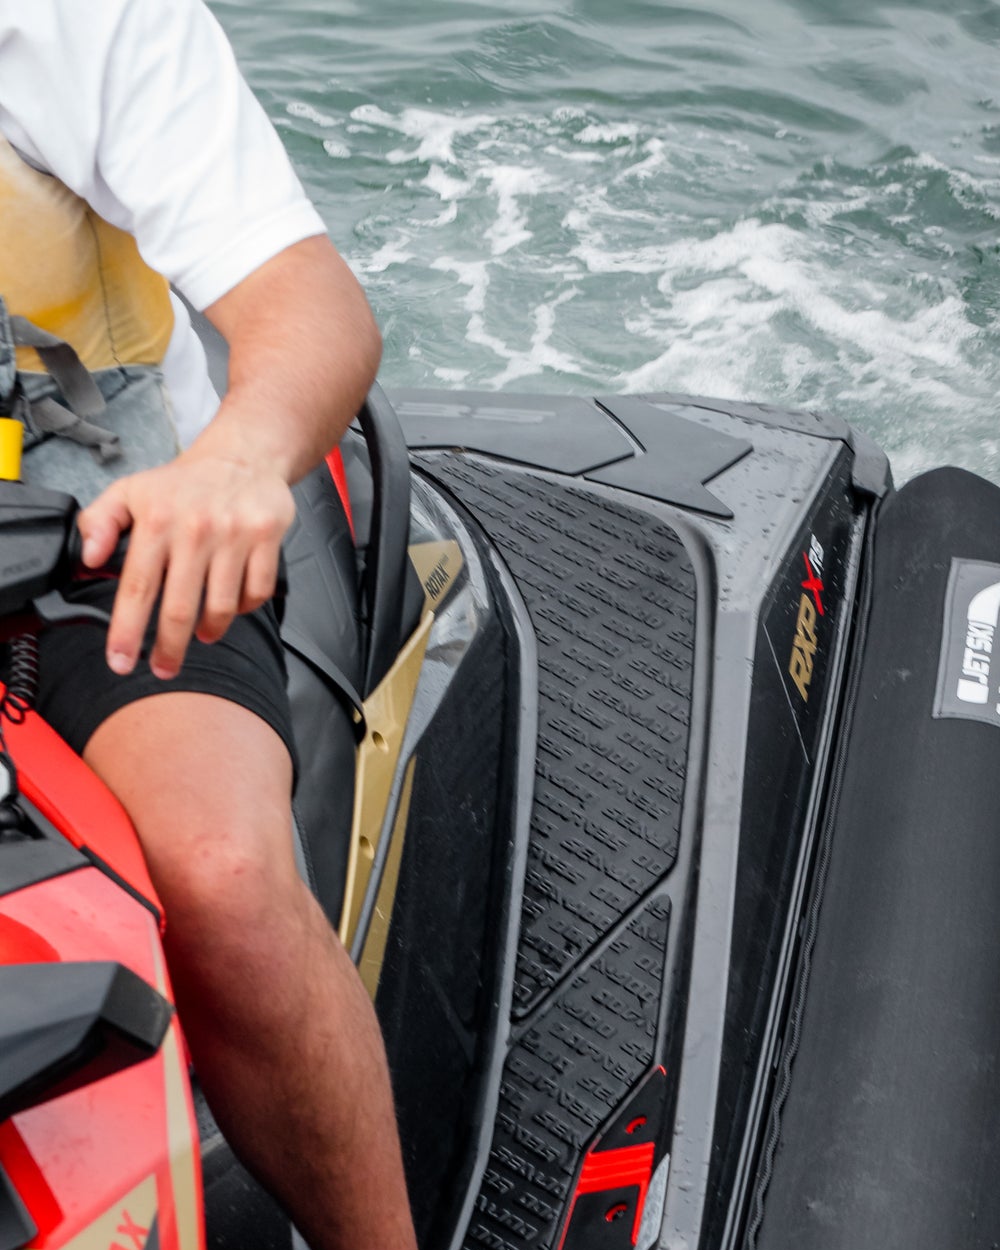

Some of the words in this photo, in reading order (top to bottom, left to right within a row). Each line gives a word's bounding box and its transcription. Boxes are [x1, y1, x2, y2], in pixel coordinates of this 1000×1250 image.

[424, 563, 450, 601] ROTAX
[789, 592, 818, 703] RXP
[966, 620, 995, 653] SKI
[962, 647, 990, 686] JET
